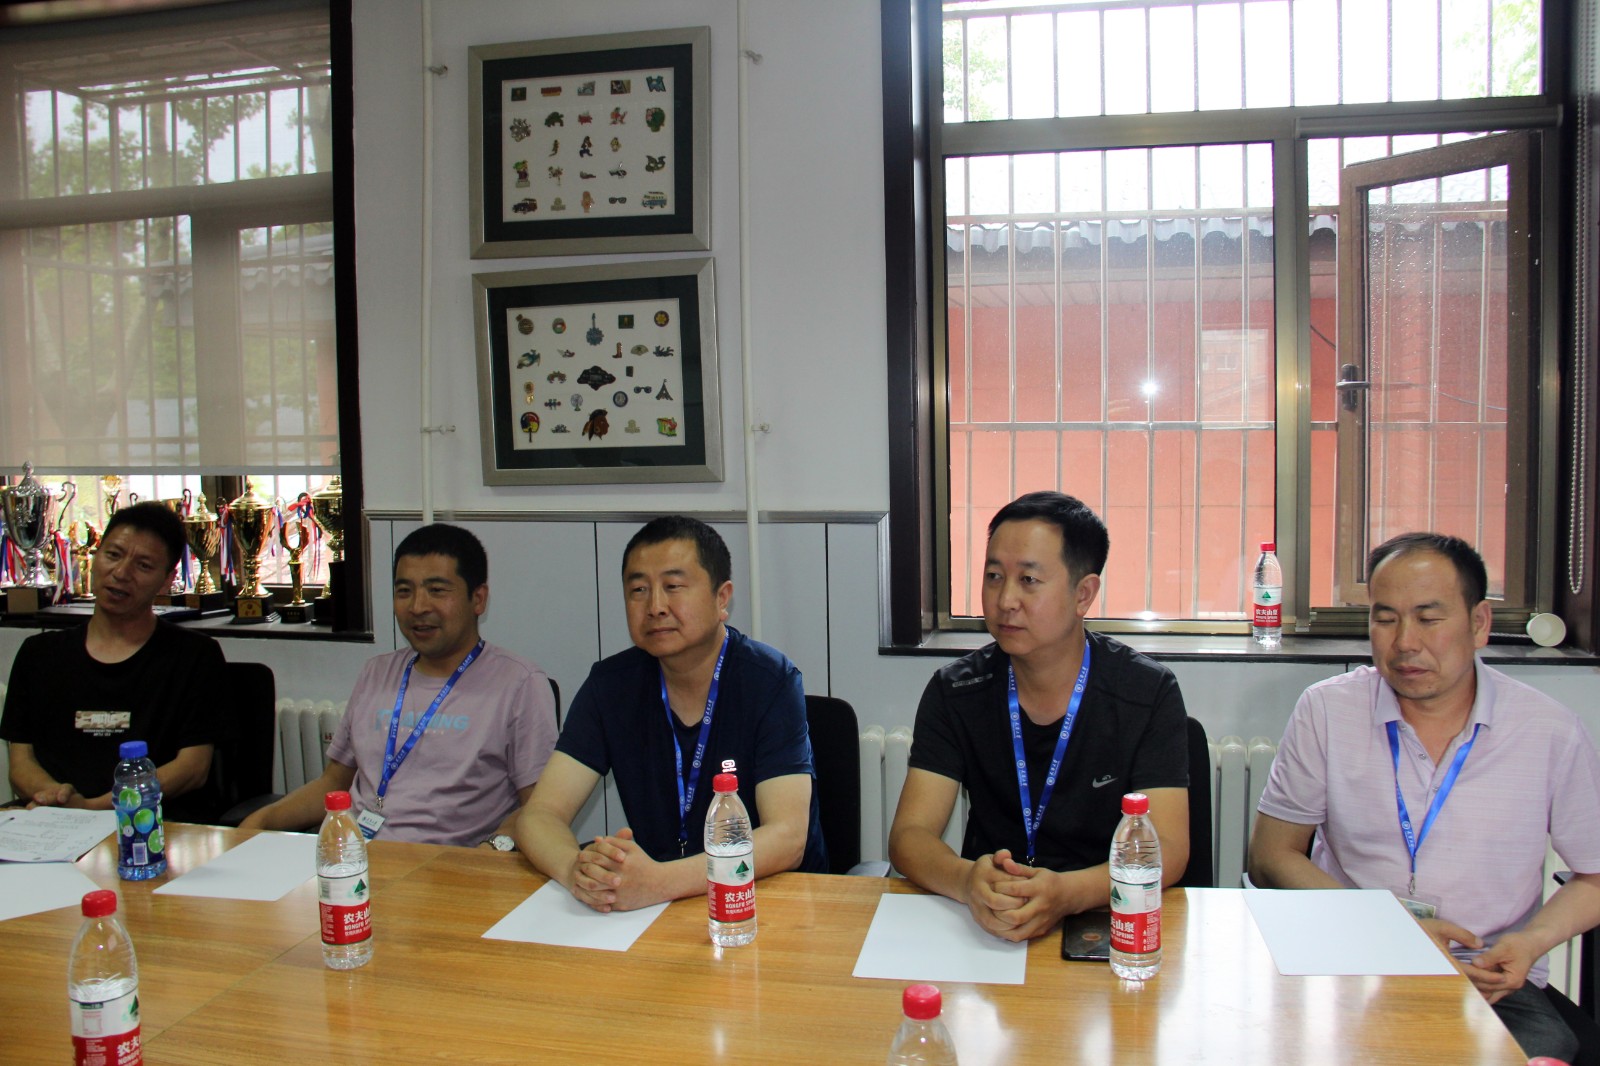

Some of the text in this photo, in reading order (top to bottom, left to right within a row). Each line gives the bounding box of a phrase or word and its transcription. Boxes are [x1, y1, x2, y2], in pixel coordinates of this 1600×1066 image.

[725, 888, 755, 902] 农夫山
[1116, 930, 1134, 940] SPRING
